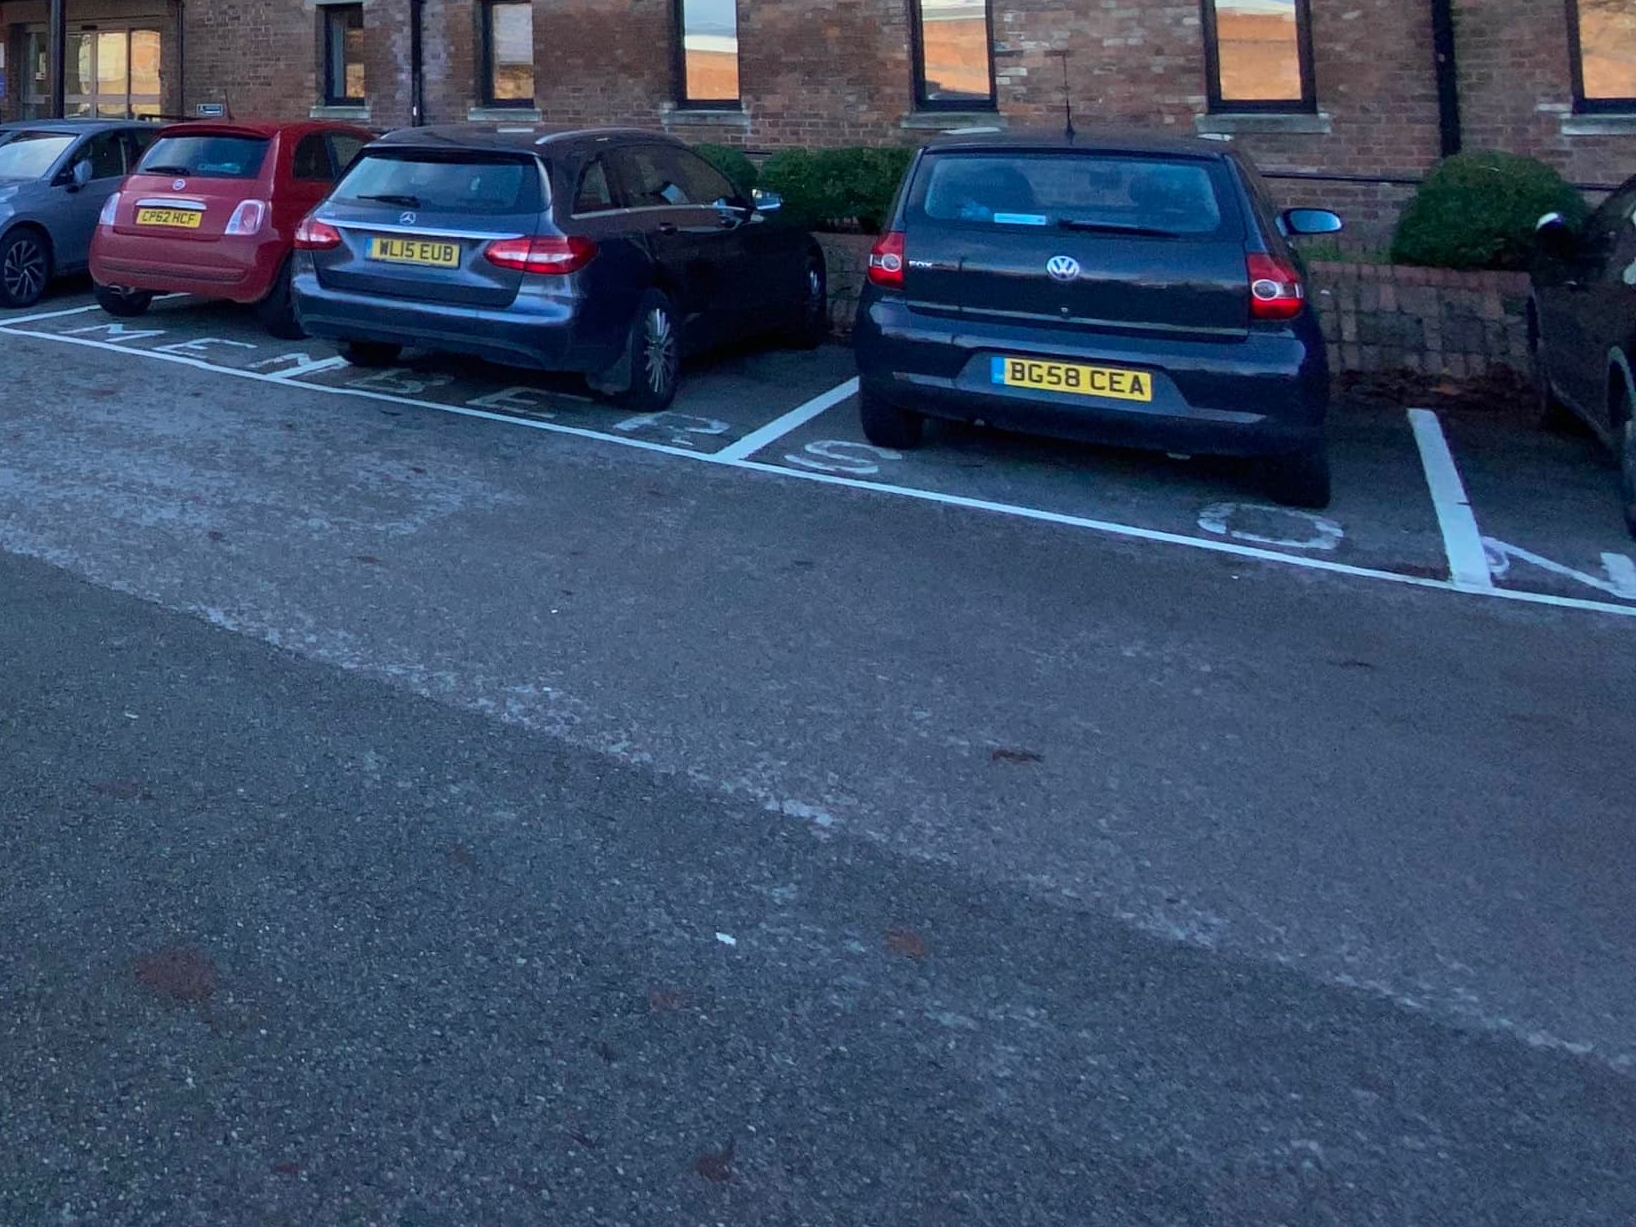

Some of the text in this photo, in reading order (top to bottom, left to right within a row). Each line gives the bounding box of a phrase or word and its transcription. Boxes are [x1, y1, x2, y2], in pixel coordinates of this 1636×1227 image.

[141, 210, 197, 225] CP62 HCF
[379, 240, 454, 262] WL15 EUB
[1010, 361, 1145, 395] BG58 CEA
